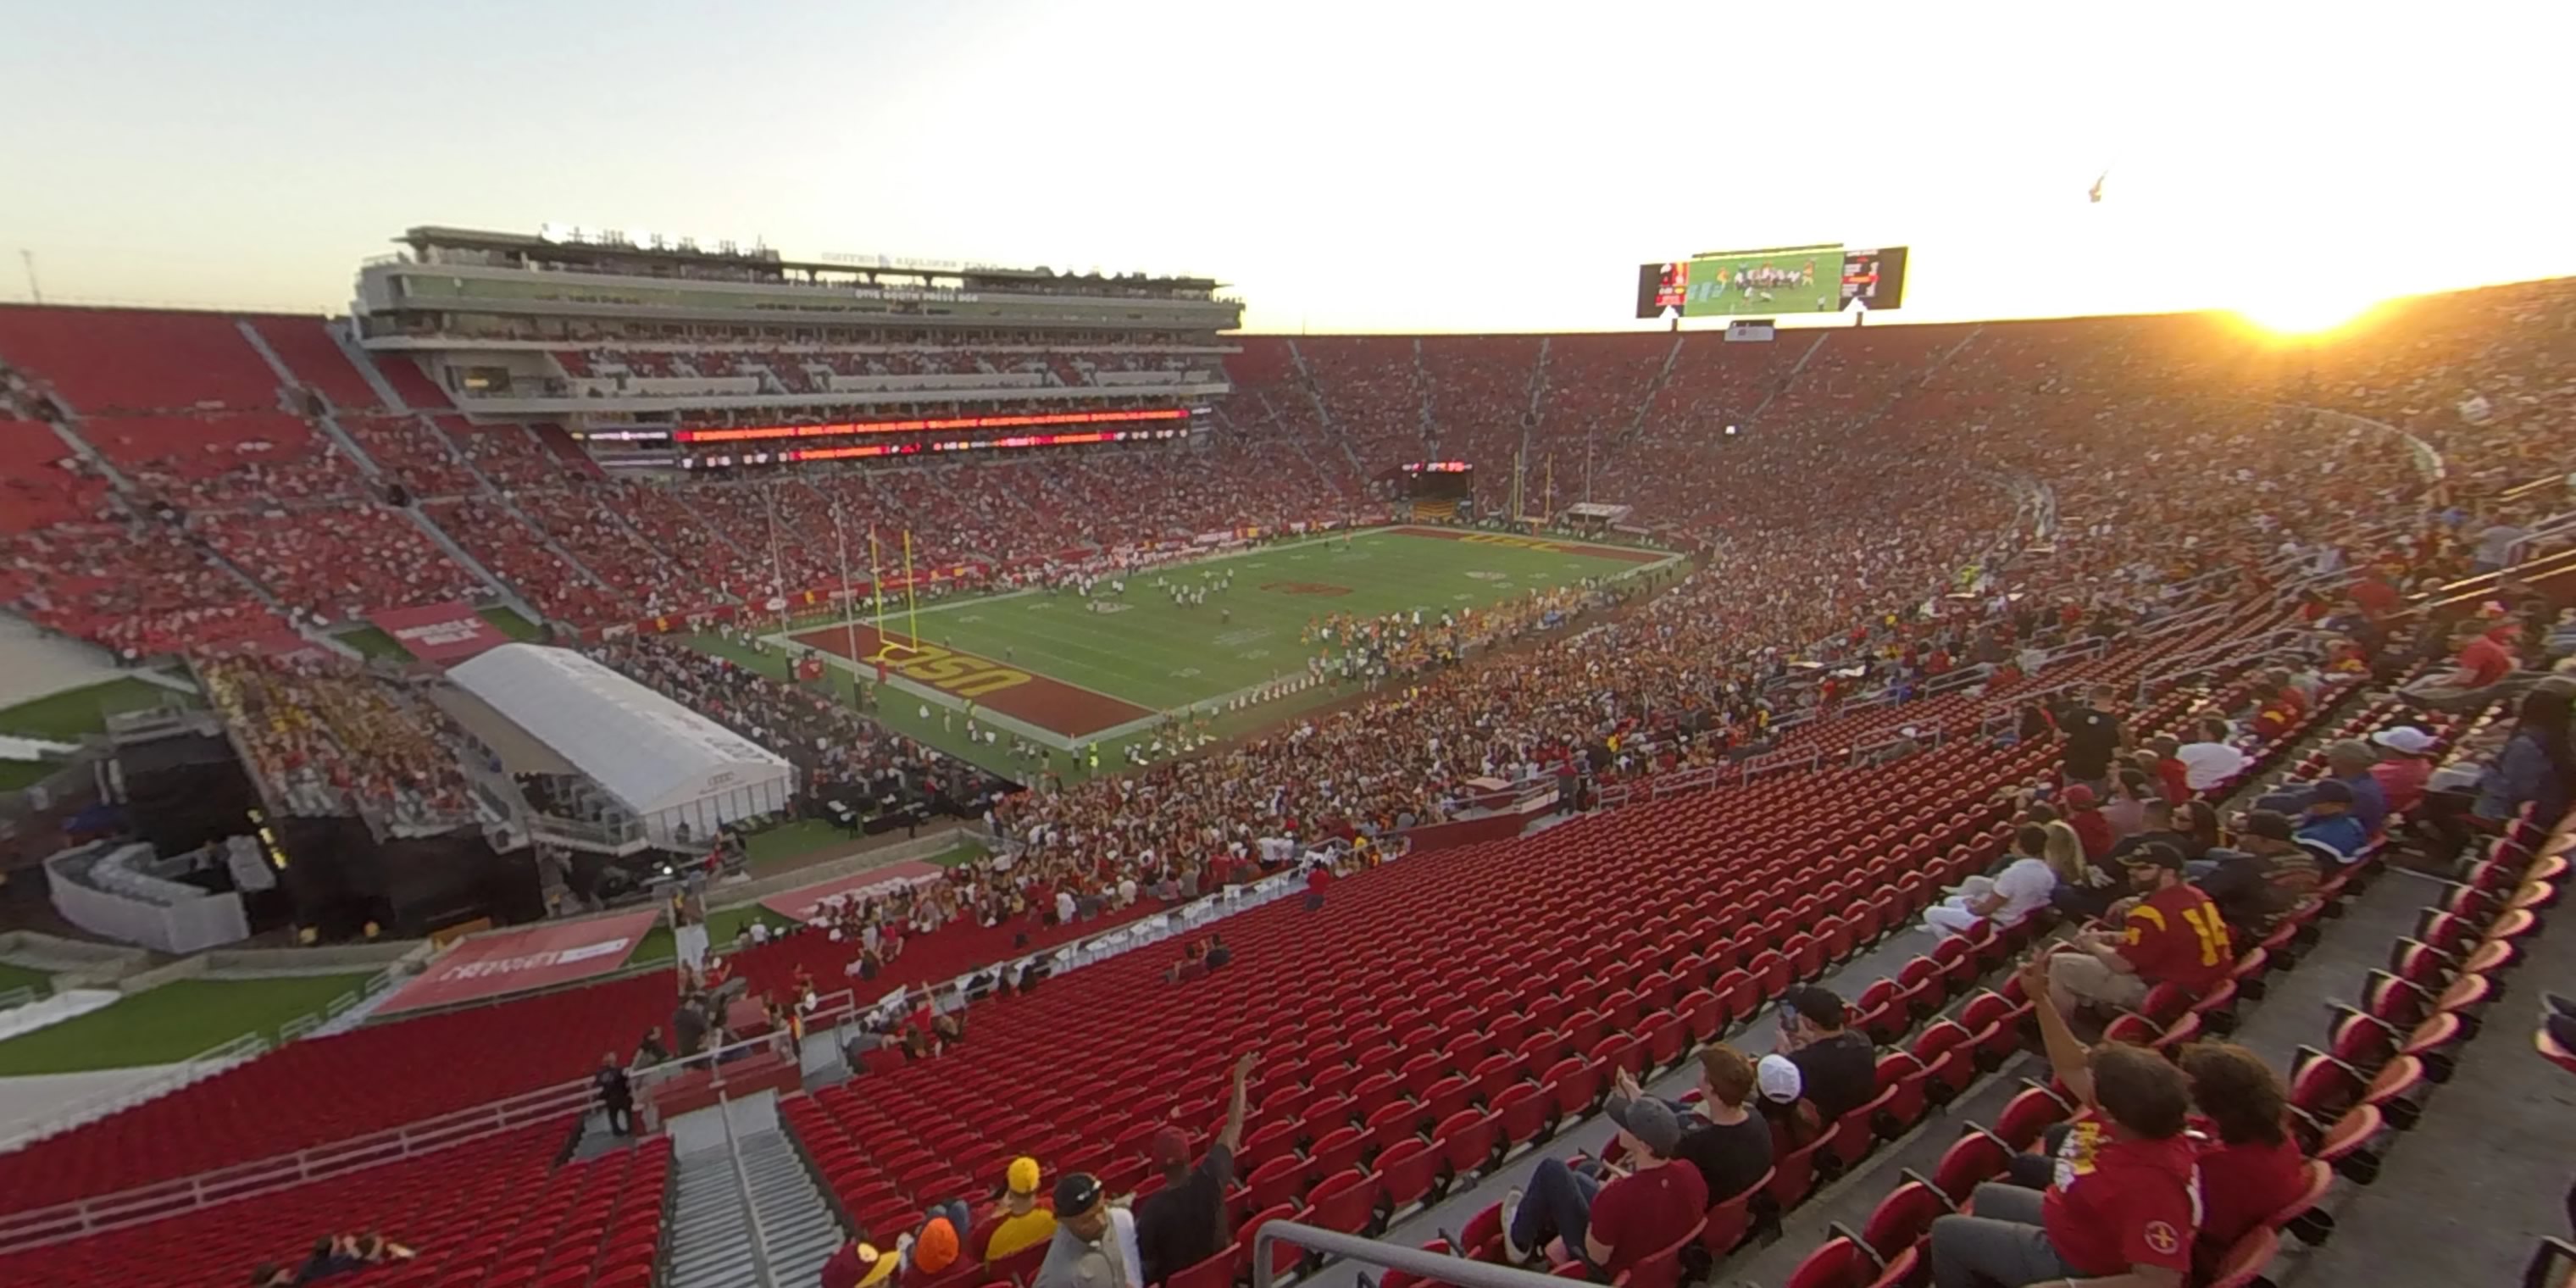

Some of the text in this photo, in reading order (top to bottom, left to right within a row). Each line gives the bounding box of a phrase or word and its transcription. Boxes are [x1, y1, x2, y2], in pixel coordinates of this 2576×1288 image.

[821, 252, 876, 264] UNITED
[896, 257, 958, 269] AIRLINES
[922, 292, 955, 302] PRESS
[861, 645, 1032, 697] USC
[2182, 901, 2231, 967] 14
